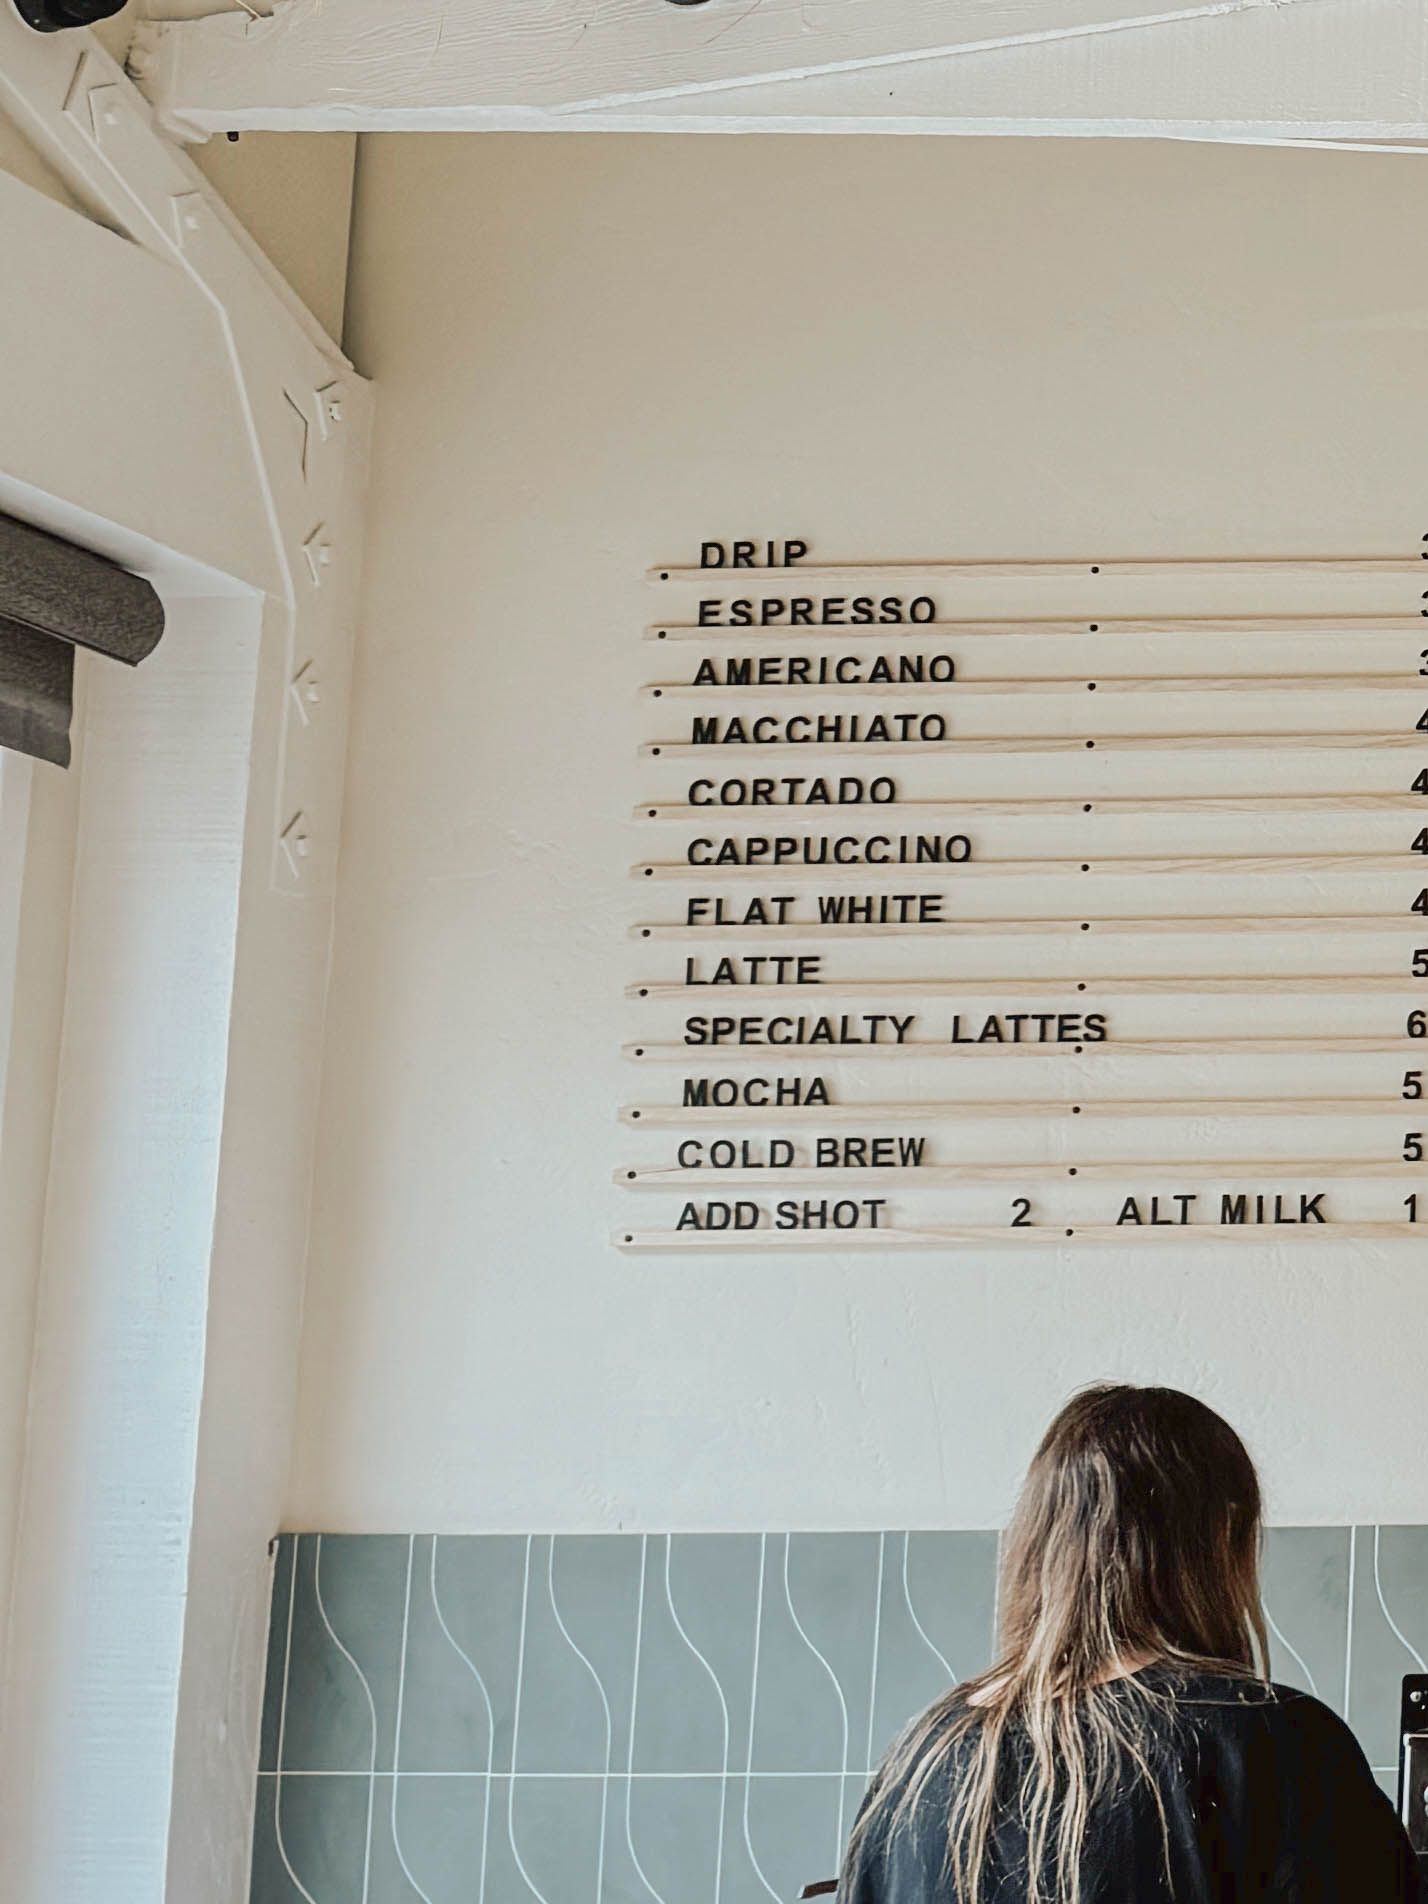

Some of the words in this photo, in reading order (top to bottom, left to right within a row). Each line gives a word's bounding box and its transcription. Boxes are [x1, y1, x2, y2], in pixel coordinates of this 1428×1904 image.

[699, 540, 808, 569] DRIP
[696, 596, 936, 628] ESPRESSO
[691, 655, 956, 687] AMERICANO
[691, 713, 946, 745] MACCHIATO
[688, 776, 896, 807] CORTADO
[687, 834, 972, 866] CAPPUCCINO
[686, 896, 796, 927] FLAT
[818, 894, 946, 925] WHITE
[685, 956, 822, 986] LATTE
[684, 1015, 915, 1046] SPECIALTY
[951, 1013, 1108, 1044] LATTES
[1407, 1009, 1428, 1039] 6
[682, 1077, 831, 1107] MOCHA
[1402, 1070, 1423, 1100] 5
[678, 1139, 795, 1169] COLD
[816, 1137, 925, 1168] BREW
[1402, 1132, 1423, 1162] 5
[676, 1201, 759, 1231] ADD
[775, 1199, 886, 1230] SHOT
[1011, 1198, 1033, 1227] 2
[1116, 1194, 1197, 1226] ALT
[1220, 1193, 1327, 1225] MILK
[1404, 1193, 1417, 1223] 1
